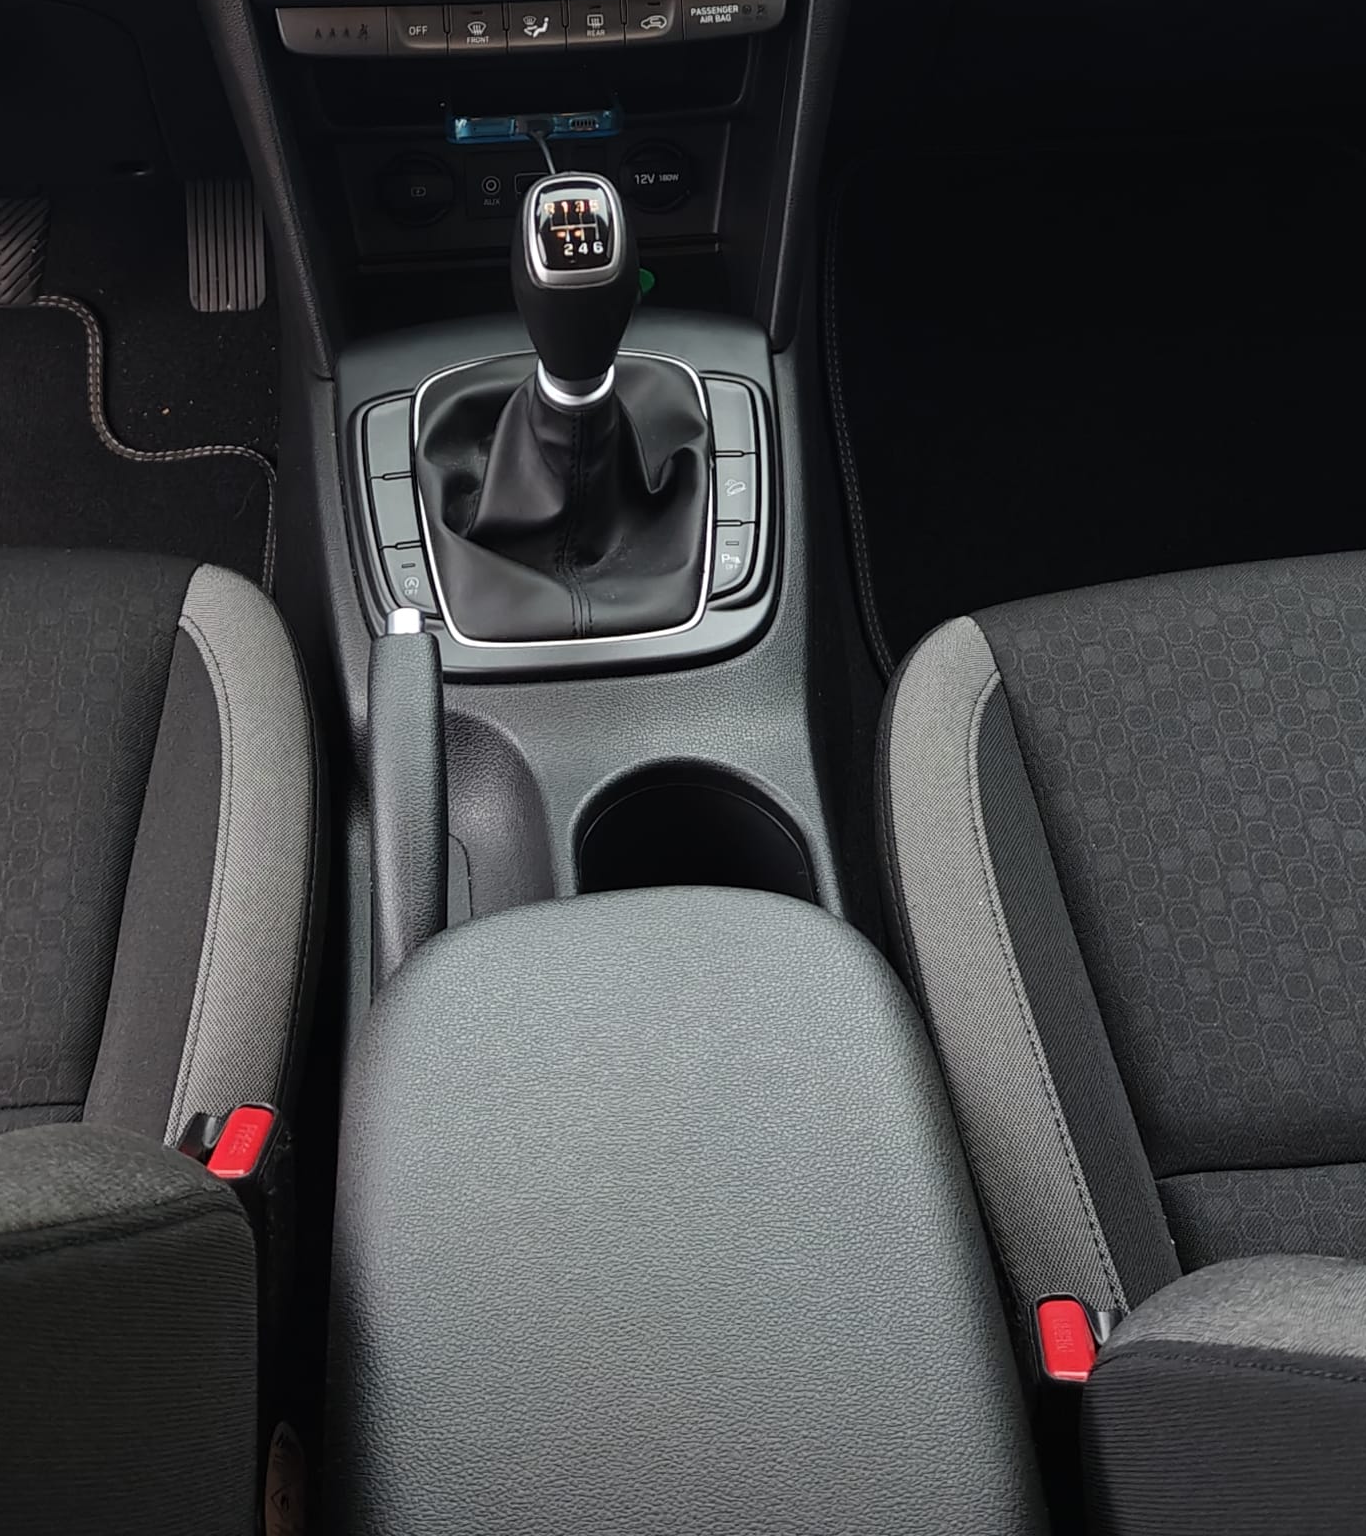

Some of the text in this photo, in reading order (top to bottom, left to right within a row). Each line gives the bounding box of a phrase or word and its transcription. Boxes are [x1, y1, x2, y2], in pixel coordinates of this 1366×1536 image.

[690, 5, 739, 17] PASSENGER
[699, 15, 714, 24] AIR
[715, 14, 732, 23] BAG
[409, 25, 428, 36] OFF
[586, 29, 606, 38] REAR
[466, 35, 490, 45] FRONT
[634, 173, 656, 185] 12V
[561, 201, 569, 214] 1
[563, 241, 604, 256] 2 4 6
